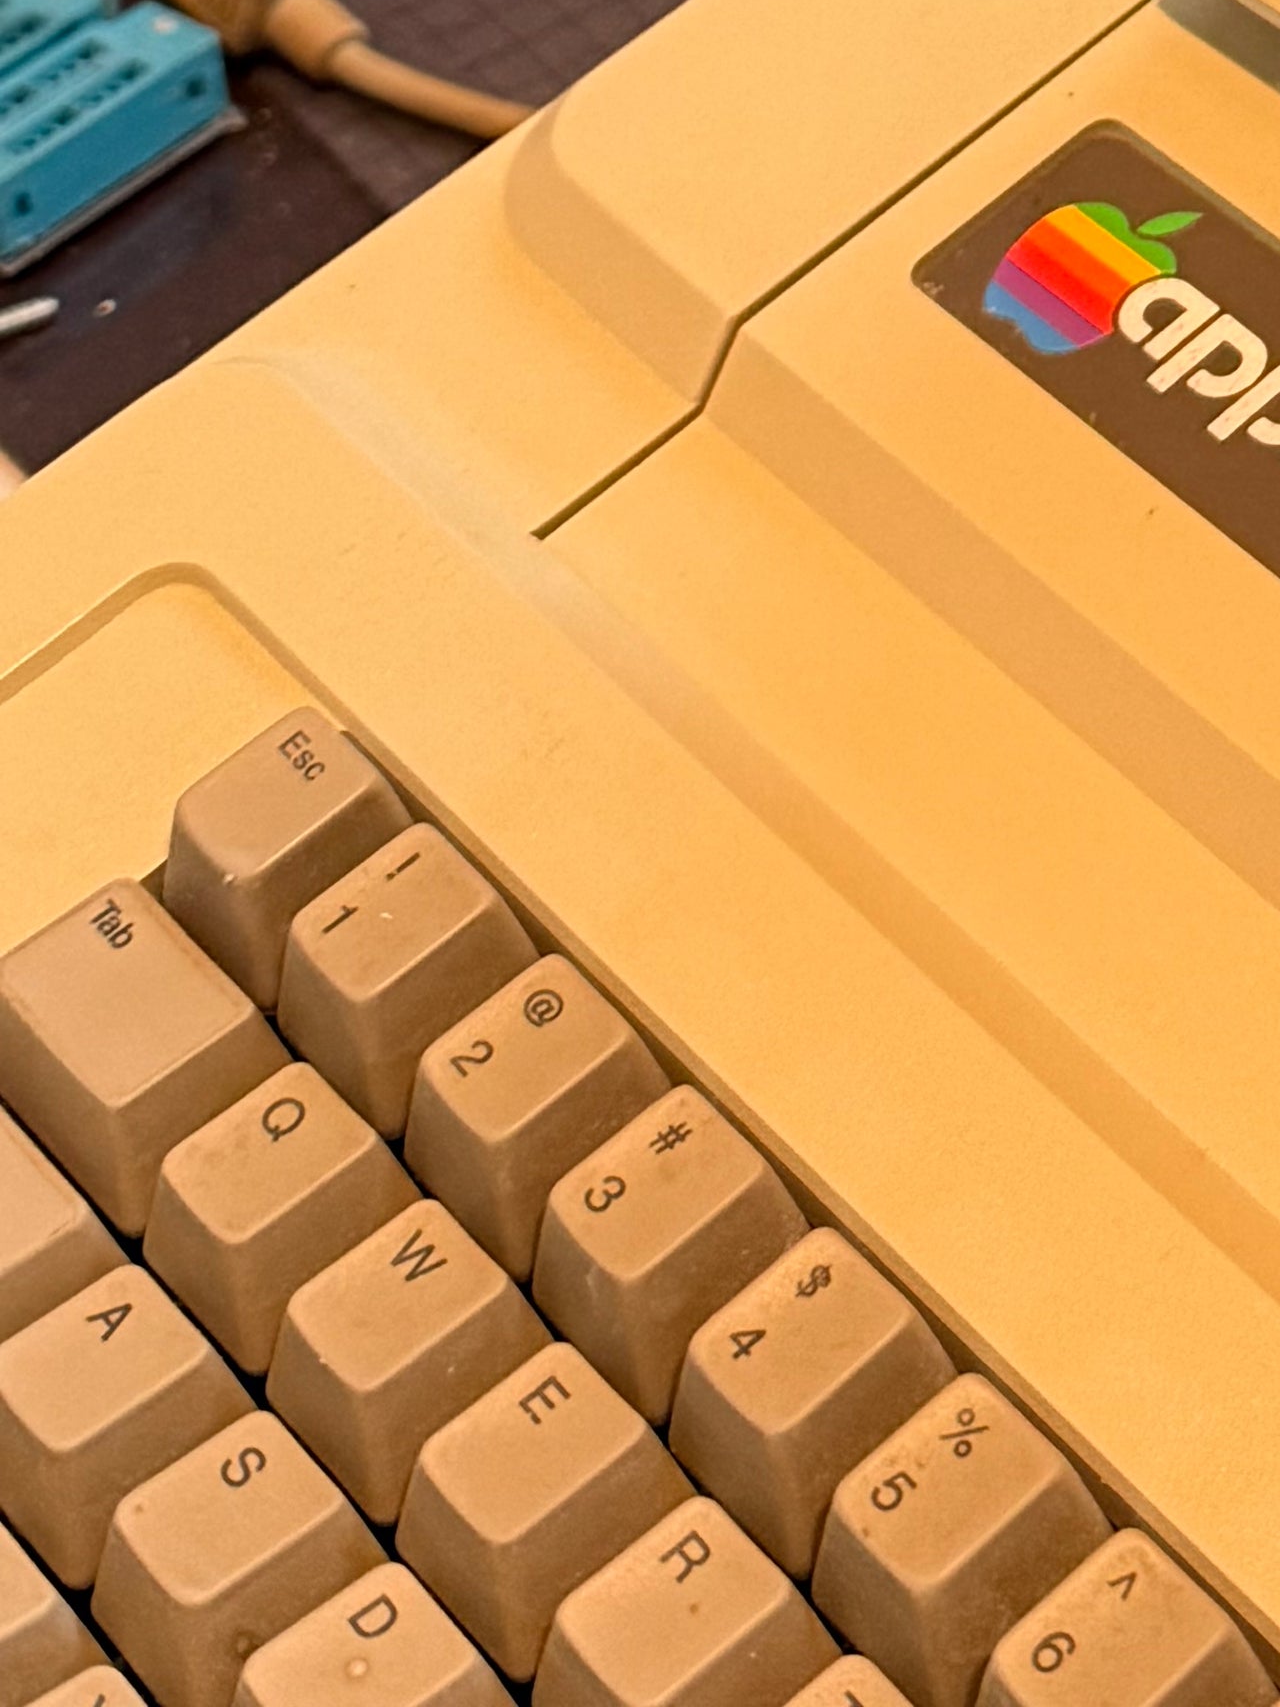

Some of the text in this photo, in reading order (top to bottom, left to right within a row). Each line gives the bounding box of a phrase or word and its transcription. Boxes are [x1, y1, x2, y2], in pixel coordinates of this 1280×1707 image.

[276, 729, 326, 783] Esc
[89, 898, 135, 950] Tab
[321, 903, 360, 936] 1
[523, 988, 565, 1027] @
[449, 1038, 495, 1078] 2
[261, 1096, 306, 1143] Q
[649, 1120, 694, 1156] #
[583, 1175, 627, 1213] 3
[389, 1228, 448, 1283] W
[795, 1264, 834, 1299] $
[85, 1302, 134, 1342] A
[728, 1327, 768, 1361] 4
[517, 1374, 572, 1426] E
[938, 1407, 990, 1459] %
[219, 1446, 268, 1489] S
[869, 1470, 918, 1513] 5
[658, 1529, 713, 1585] R
[347, 1592, 399, 1639] D
[1031, 1630, 1077, 1674] 6
